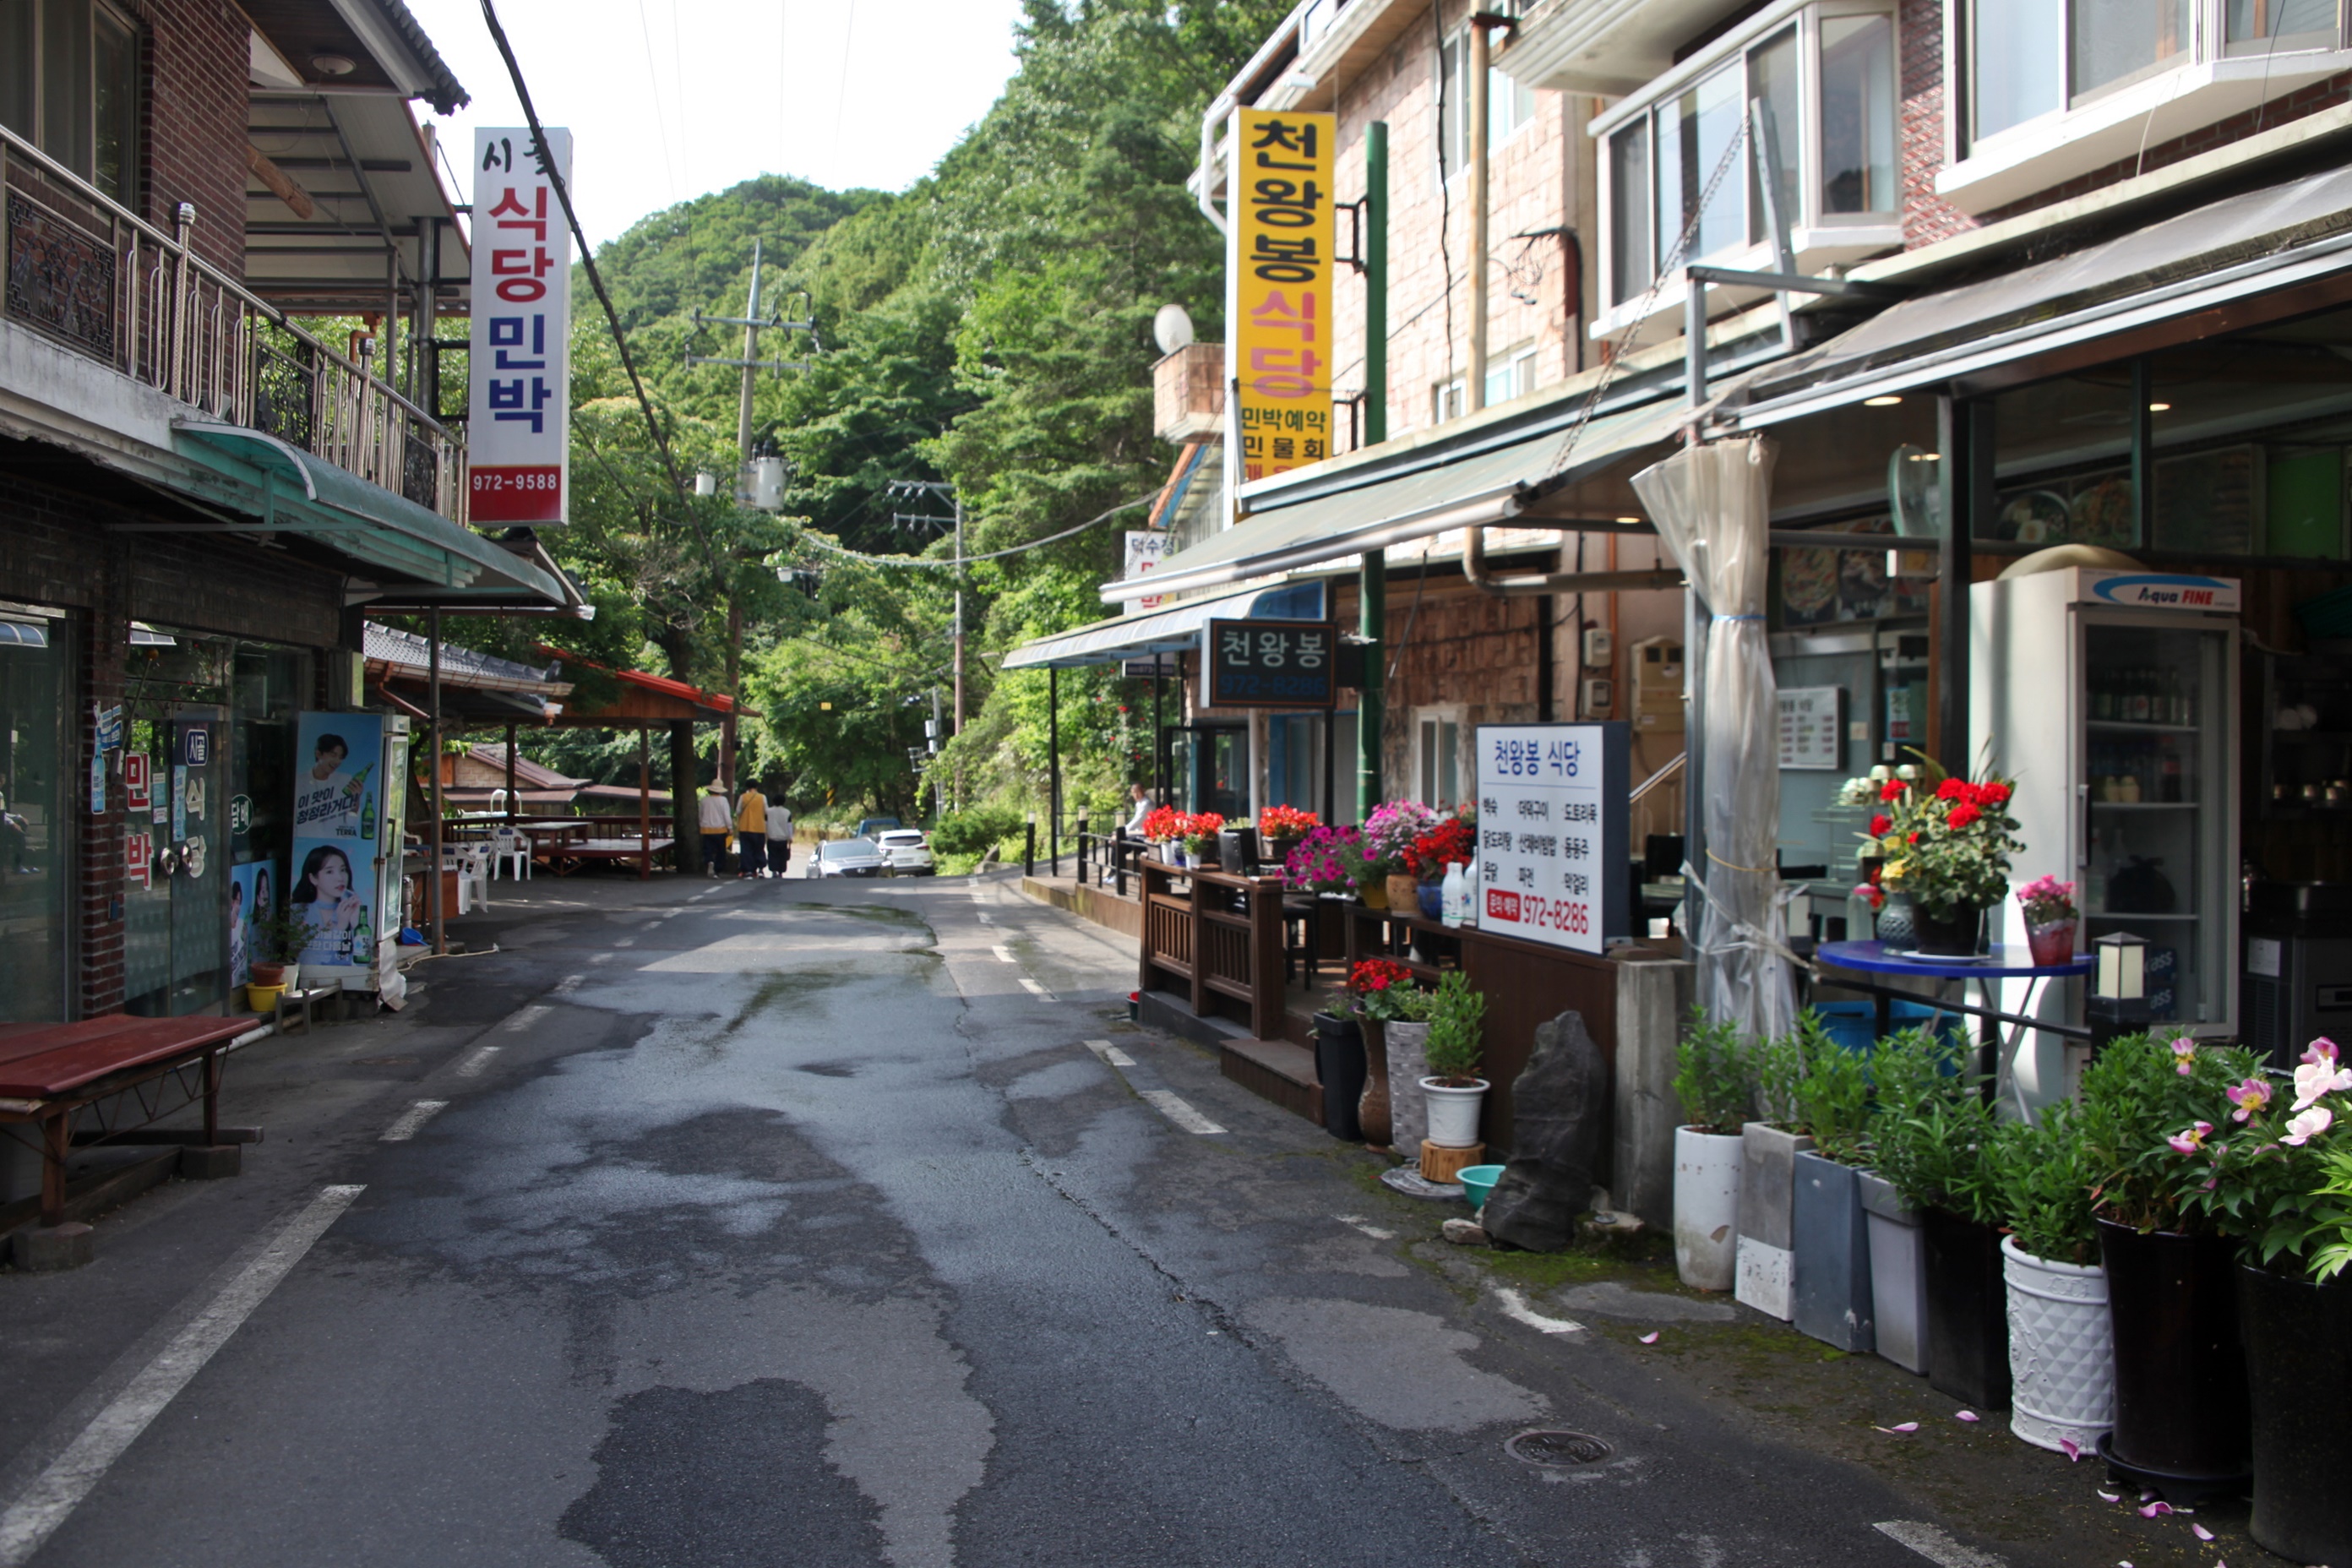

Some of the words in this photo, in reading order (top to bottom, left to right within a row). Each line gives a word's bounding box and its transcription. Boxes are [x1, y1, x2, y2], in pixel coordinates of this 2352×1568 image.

[487, 187, 554, 302] 식당
[488, 313, 552, 433] 민박
[473, 474, 557, 491] 972-9588
[2182, 590, 2214, 606] FINE
[1222, 630, 1326, 668] 천왕봉
[1220, 674, 1326, 696] 972-8286
[188, 734, 206, 761] 시골
[1494, 739, 1539, 776] 천왕봉
[1548, 741, 1581, 777] 식당
[1518, 799, 1549, 821] 더덕구이
[1564, 803, 1598, 825] 도토리묵
[1564, 836, 1590, 861] 동동주
[1518, 867, 1534, 888] 파전
[1564, 872, 1589, 897] 막걸리
[1523, 895, 1589, 935] 972-8286
